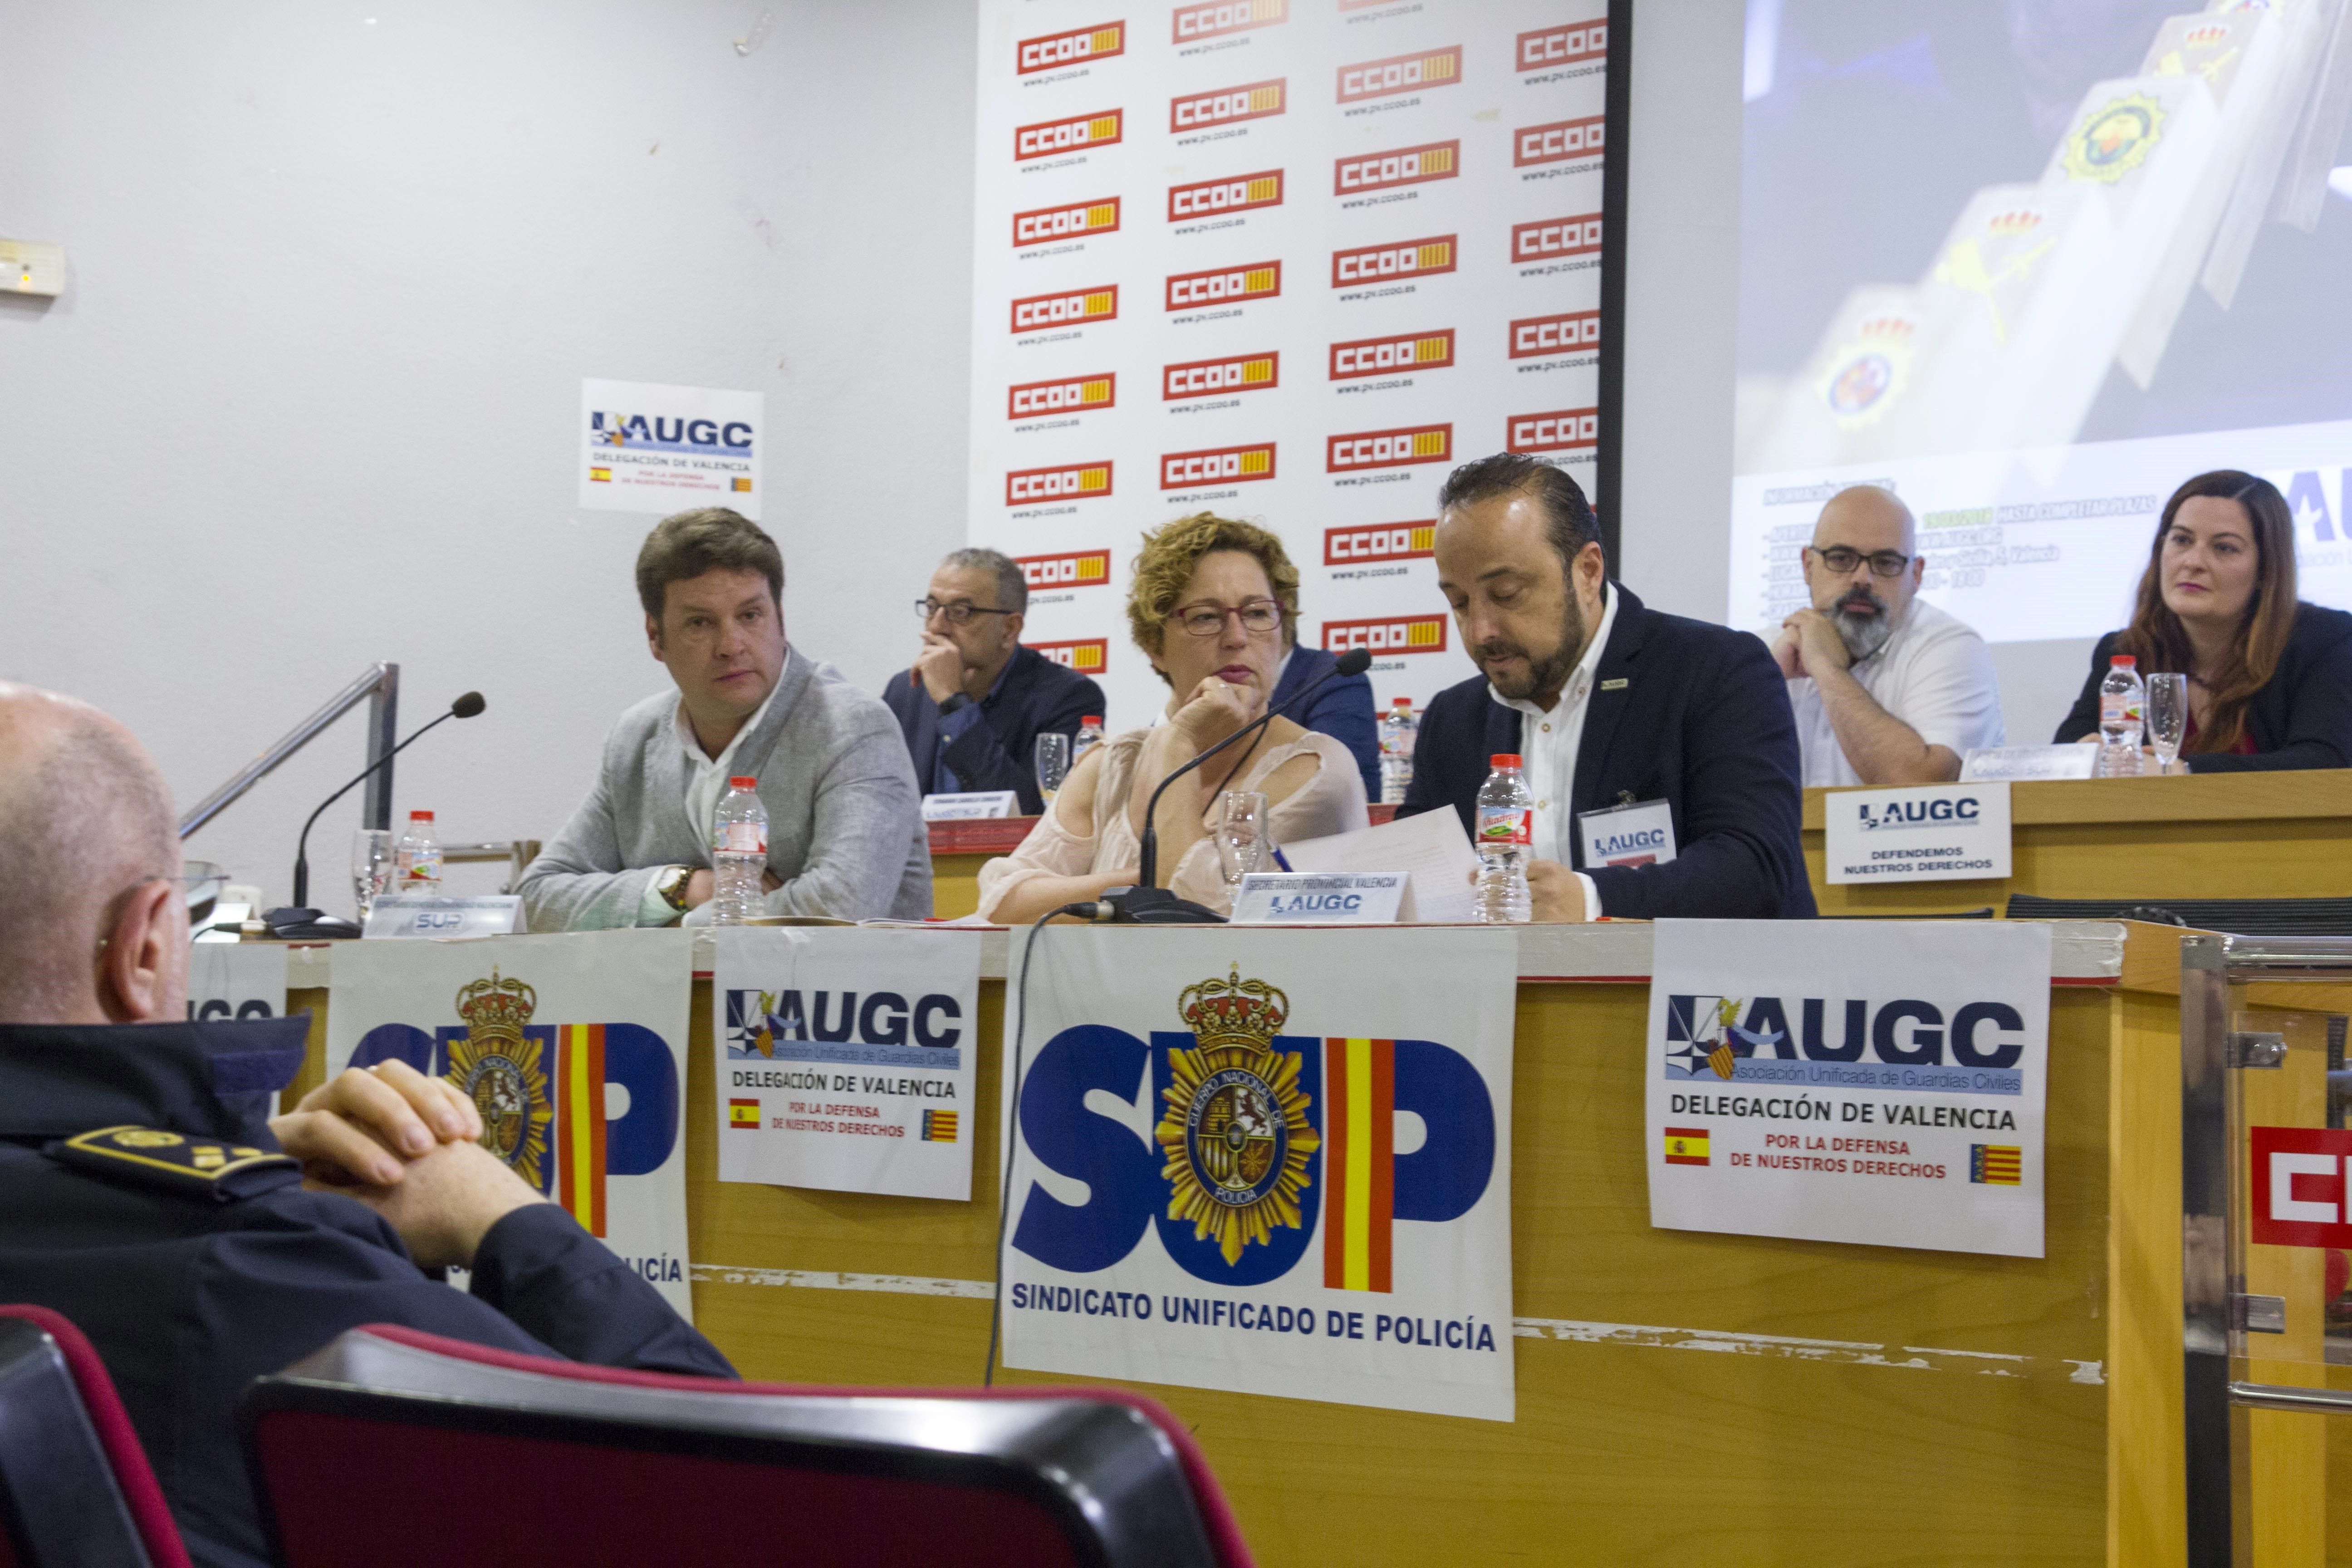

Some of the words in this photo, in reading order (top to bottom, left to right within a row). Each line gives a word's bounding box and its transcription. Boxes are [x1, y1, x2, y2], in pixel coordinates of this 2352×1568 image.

[1180, 2, 1252, 36] CCOO
[1024, 34, 1091, 66] CCOO
[1524, 26, 1605, 63] CCOO
[1344, 59, 1422, 95] CCOO
[1176, 92, 1250, 125] CCOO
[1021, 122, 1088, 152] CCOO
[1522, 123, 1603, 158] CCOO
[1342, 154, 1420, 187] CCOO
[1175, 182, 1247, 213] CCOO
[1019, 209, 1086, 239] CCOO
[1519, 220, 1601, 254] CCOO
[1339, 248, 1417, 279] CCOO
[1172, 273, 1244, 303] CCOO
[1017, 297, 1083, 325] CCOO
[1518, 318, 1598, 350] CCOO
[1337, 342, 1414, 372] CCOO
[1170, 364, 1241, 392] CCOO
[1014, 385, 1081, 412] CCOO
[623, 414, 753, 449] AUGC
[1515, 416, 1596, 446] CCOO
[1334, 436, 1412, 464] CCOO
[692, 460, 750, 471] VALENCIA
[1167, 455, 1239, 481] CCOO
[1012, 472, 1078, 498] CCOO
[1332, 530, 1409, 557] CCOO
[1021, 560, 1076, 584] COO
[1329, 625, 1406, 650] CCOO
[1883, 797, 1980, 823] AUGC
[1608, 828, 1665, 851] AUGC
[1871, 846, 1964, 860] DEFENDEMOS
[1844, 863, 1913, 875] NUESTROS
[1917, 859, 1993, 871] DERECHOS
[1287, 894, 1362, 911] AUGC
[774, 990, 962, 1048] AUGC
[1733, 997, 2025, 1069] AUGC
[732, 1068, 828, 1090] DELEGACIÓN
[833, 1075, 856, 1092] DE
[863, 1077, 956, 1098] VALENCIA
[1733, 1063, 1806, 1081] Asociación
[1809, 1065, 1876, 1085] Unificada
[1881, 1069, 1899, 1085] de
[1903, 1069, 1970, 1088] Guardias
[1974, 1073, 2021, 1091] Civiles
[788, 1102, 806, 1112] POR
[809, 1103, 821, 1115] LA
[825, 1103, 880, 1118] DEFENSA
[1671, 1093, 1832, 1121] DELEGACIÓN
[1842, 1102, 1874, 1123] DE
[1883, 1104, 2017, 1131] VALENCIA
[772, 1117, 784, 1129] DE
[786, 1118, 834, 1132] NUESTROS
[838, 1122, 905, 1137] DERECHOS
[1765, 1134, 1801, 1149] POR
[1806, 1136, 1828, 1151] LA
[1833, 1137, 1911, 1156] DEFENSA
[1730, 1152, 1752, 1167] DE
[1756, 1155, 1847, 1173] NUESTROS
[1852, 1159, 1946, 1179] DERECHOS
[1011, 1283, 1152, 1320] SINDICATO
[1162, 1296, 1315, 1335] UNIFICADO
[1326, 1310, 1364, 1339] DE
[1376, 1315, 1497, 1352] POLICÍA
